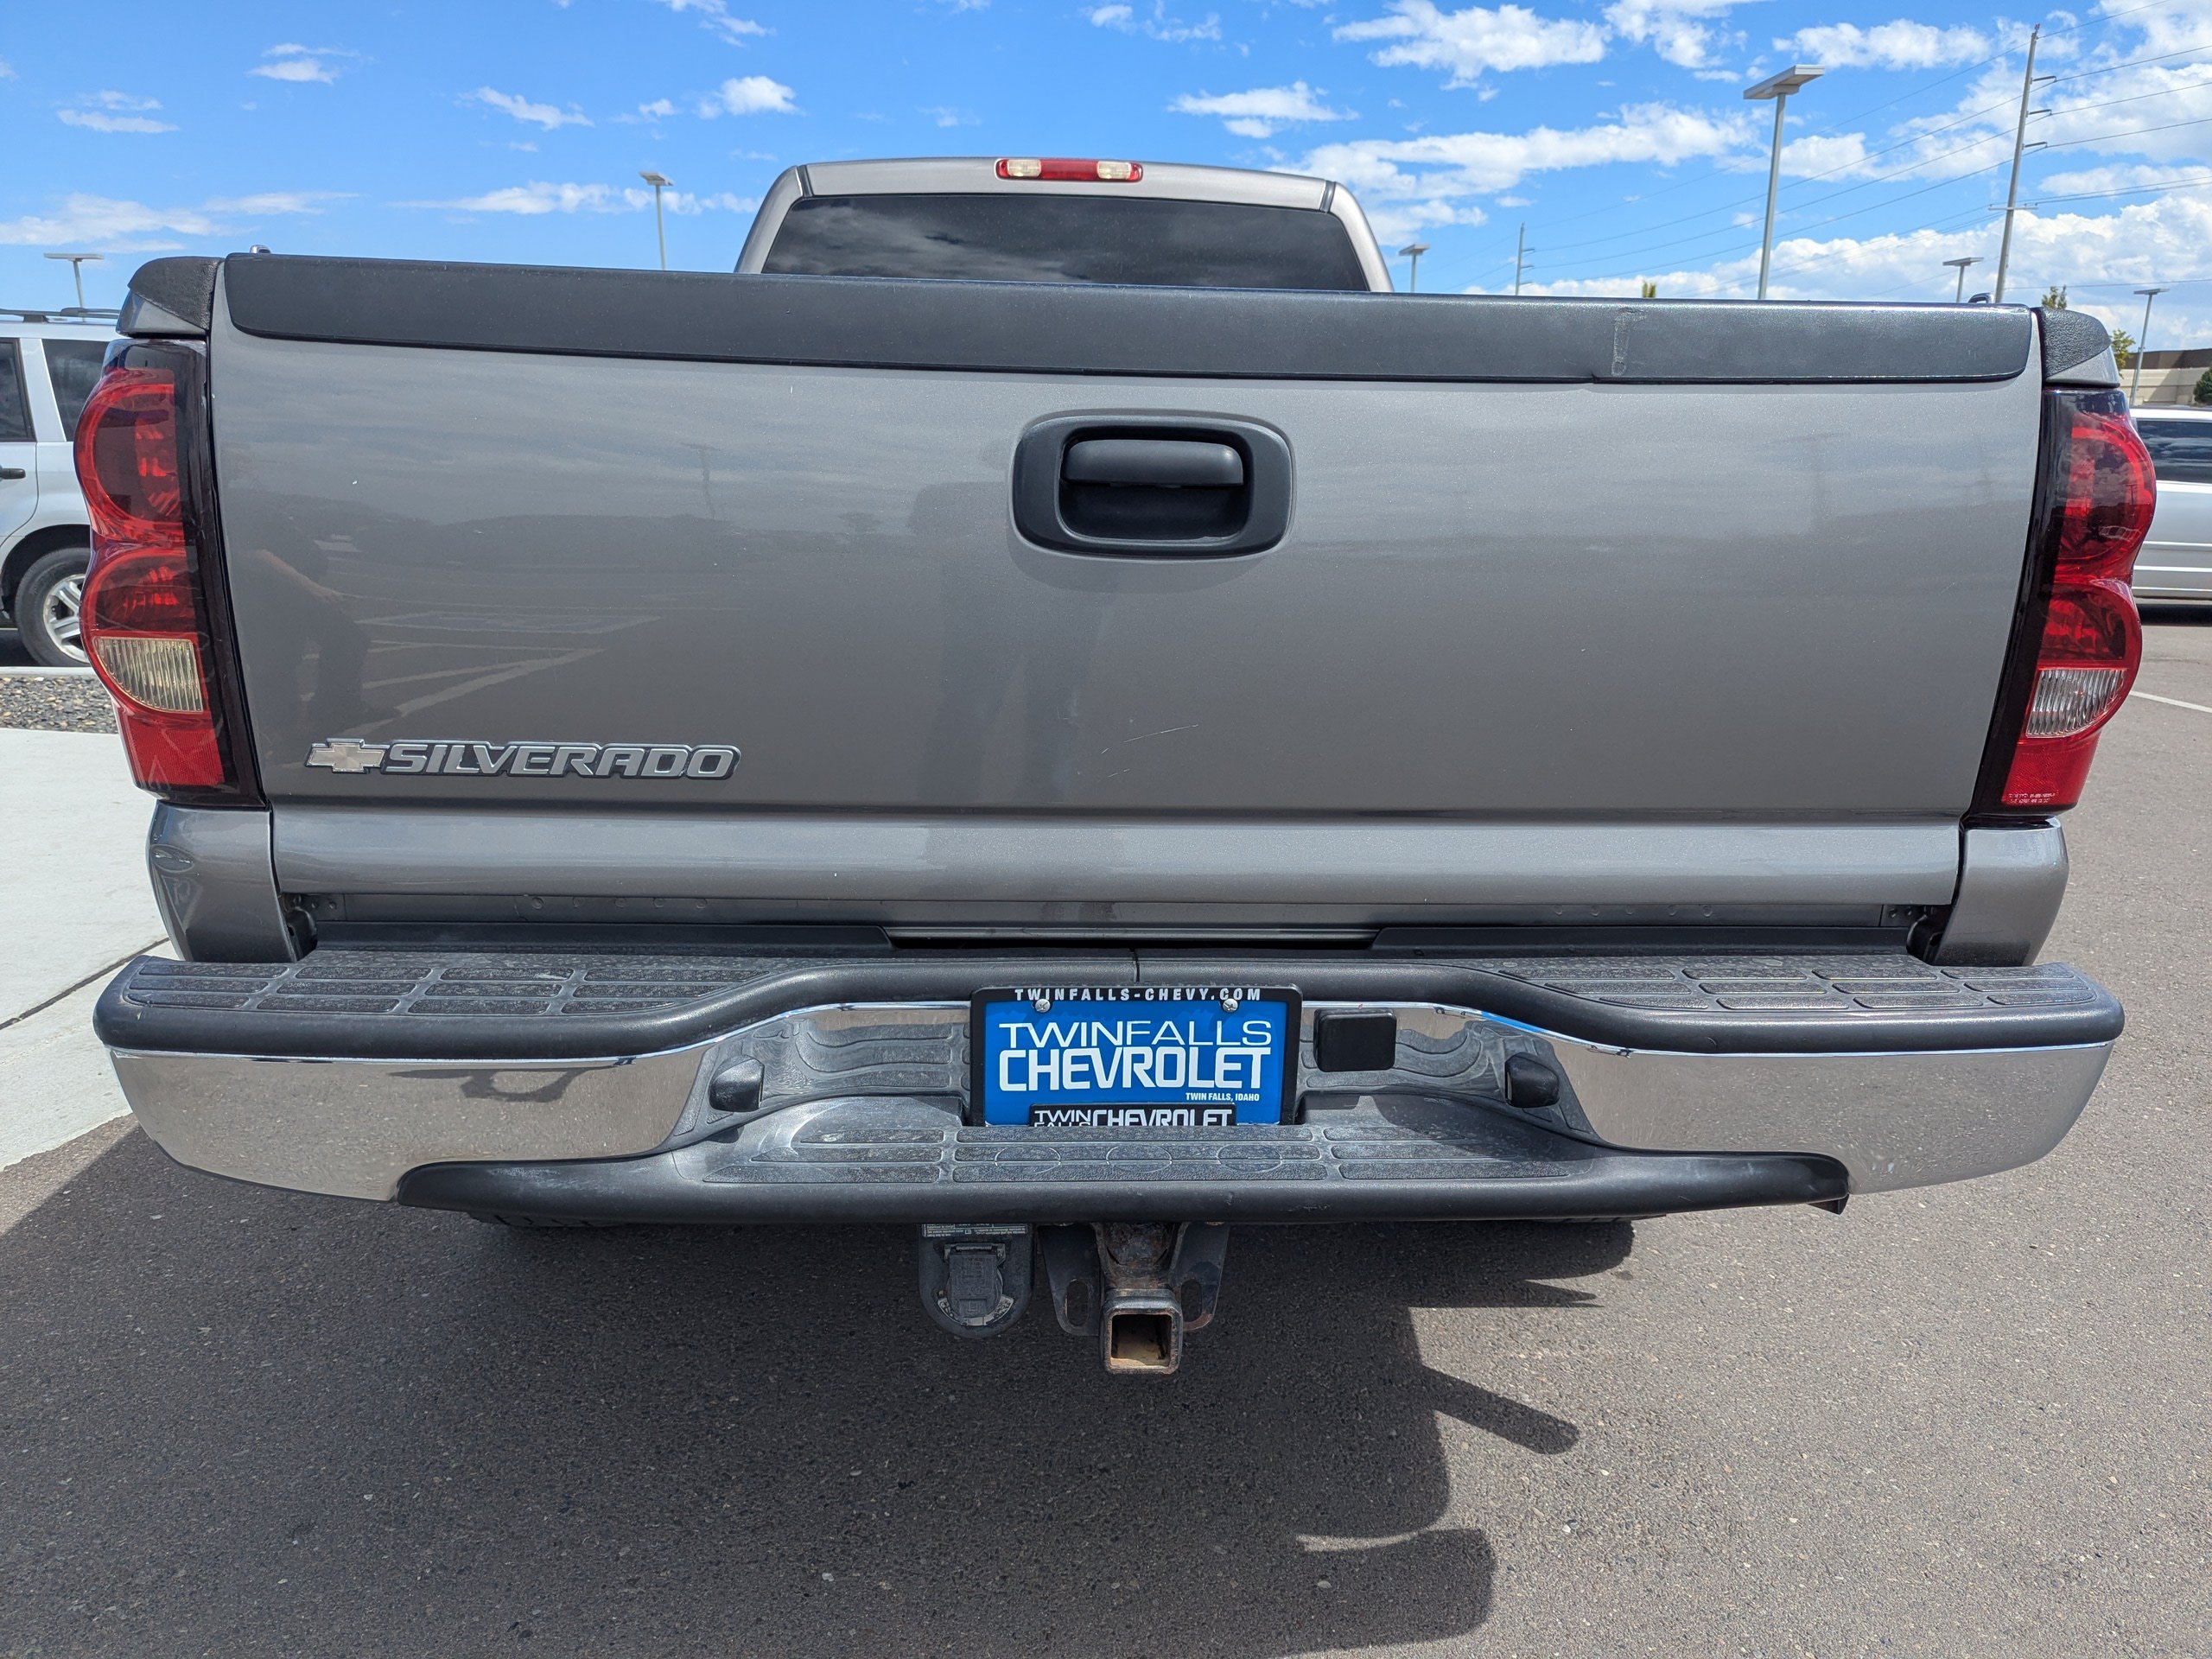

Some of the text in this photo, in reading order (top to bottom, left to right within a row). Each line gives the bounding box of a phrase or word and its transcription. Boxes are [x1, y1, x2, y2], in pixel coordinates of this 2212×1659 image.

[384, 741, 737, 778] SILVERADO
[1014, 988, 1261, 1001] TWINFALLS-CHEVY.COM
[999, 1046, 1272, 1091] CHEVROLET
[1185, 1092, 1260, 1102] TWIN FALLS, IDAHO
[1034, 1109, 1233, 1127] TWIN CHEVROLET
